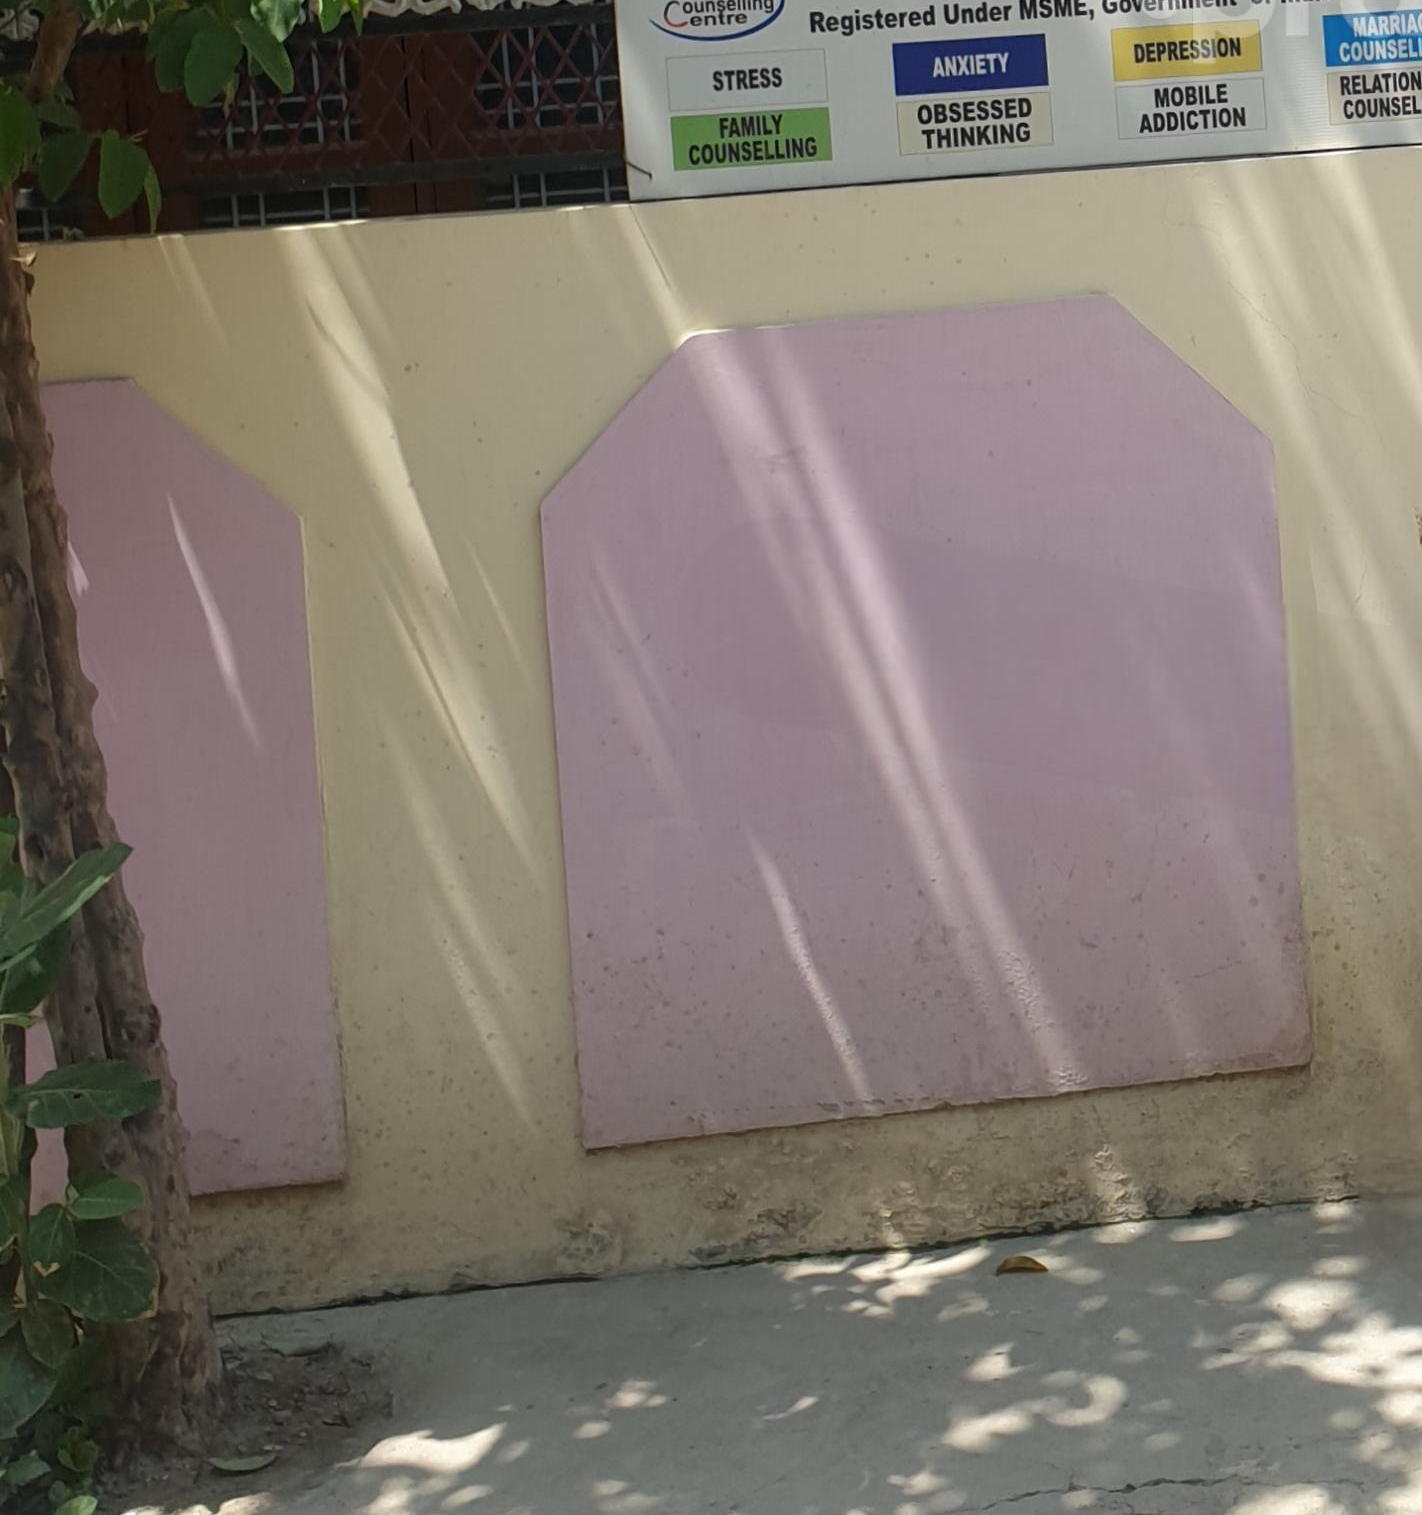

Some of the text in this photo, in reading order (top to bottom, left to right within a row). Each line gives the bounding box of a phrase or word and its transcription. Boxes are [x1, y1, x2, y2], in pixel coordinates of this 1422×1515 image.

[808, 4, 937, 37] Registered
[942, 0, 1013, 25] Under
[1132, 36, 1243, 65] DEPRESSION
[711, 66, 784, 93] STRESS
[931, 51, 1010, 80] ANXIETY
[1153, 82, 1229, 110] MOBILE
[916, 96, 1033, 127] OBSESSED
[1138, 107, 1247, 135] ADDICTION
[718, 113, 784, 140] FAMILY
[921, 121, 1032, 151] THINKING
[688, 135, 818, 167] COUNSELLING
